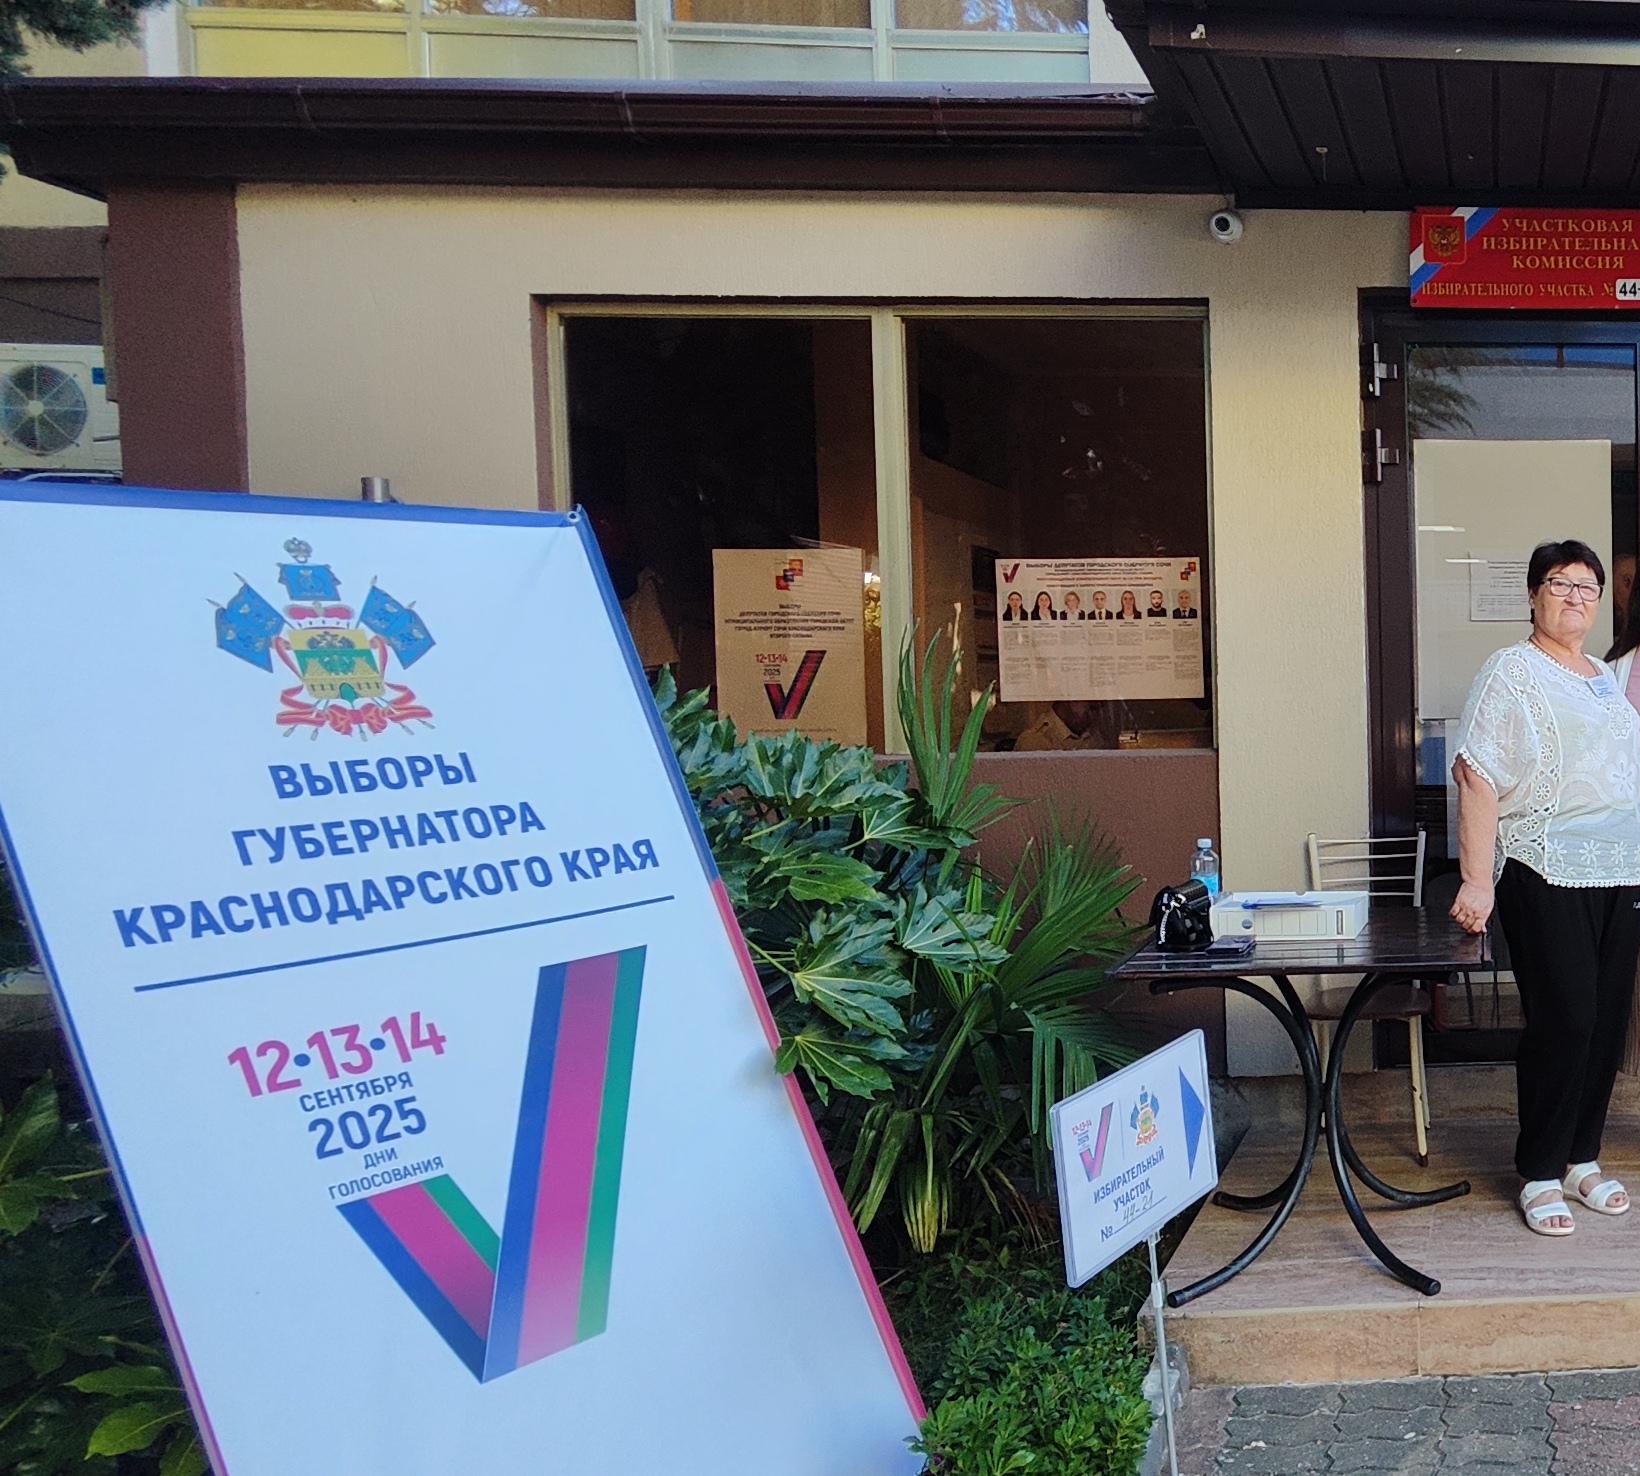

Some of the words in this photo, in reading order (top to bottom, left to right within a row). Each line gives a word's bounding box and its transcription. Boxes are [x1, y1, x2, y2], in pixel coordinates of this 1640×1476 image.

[1501, 218, 1634, 233] УЧАСТКОВАЯ
[1511, 255, 1625, 269] КОМИССИЯ
[1421, 281, 1534, 297] ИЗБИРАТЕЛЬНОГО
[1539, 283, 1595, 297] УЧАСТКА
[268, 751, 479, 801] ВЫБОРЫ
[231, 801, 546, 867] ГУБЕРНАТОРА
[112, 856, 553, 948] КРАСНОДАРСКОГО
[559, 838, 660, 883] КРАЯ
[299, 1071, 415, 1114] СЕНТЯБРЯ
[307, 1095, 427, 1160] 2025
[327, 1155, 445, 1200] ГОЛОСОВАНИЯ
[362, 1147, 399, 1170] ДНИ
[1093, 1145, 1165, 1205] ИЗБИРАТЕЛЬНЫЙ
[1113, 1177, 1152, 1213] УЧАСТОК
[1122, 1190, 1154, 1224] 44-21
[1100, 1225, 1114, 1243] №
